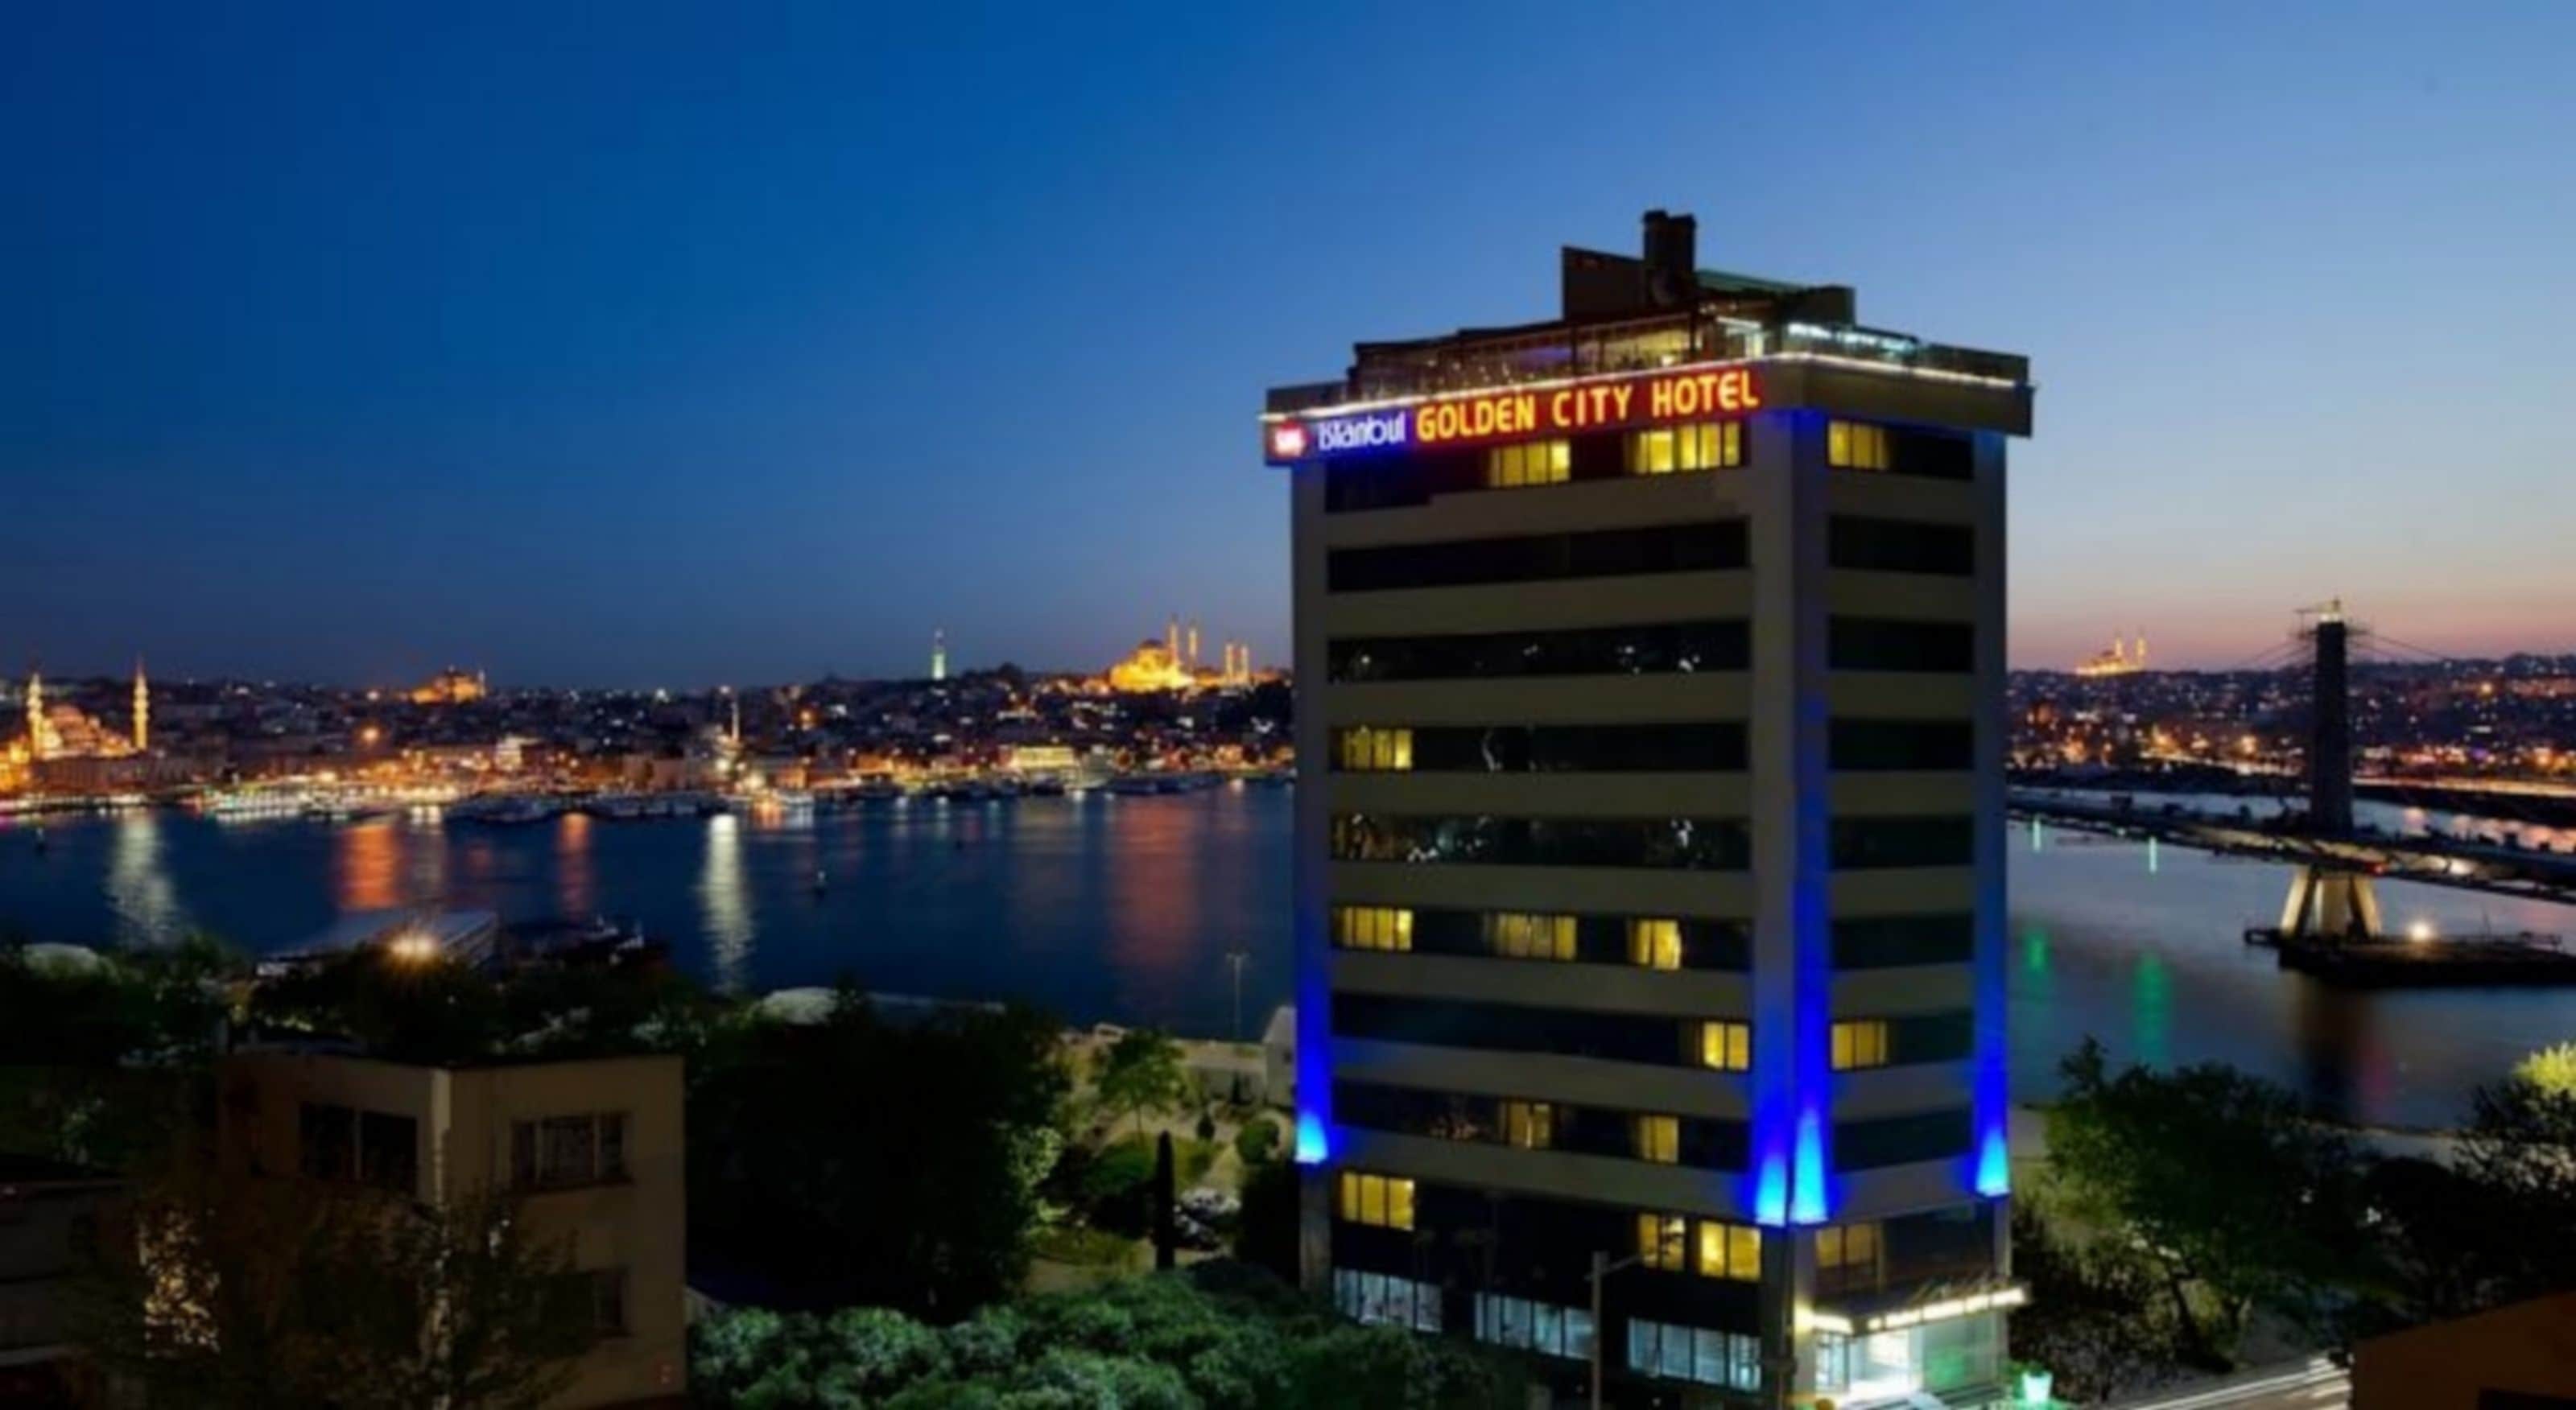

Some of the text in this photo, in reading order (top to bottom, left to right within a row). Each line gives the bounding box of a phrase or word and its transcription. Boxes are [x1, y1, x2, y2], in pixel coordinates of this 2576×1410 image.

[1417, 394, 1535, 442] GOLDEN
[1552, 384, 1633, 427] CITY
[1653, 369, 1759, 418] HOTEL
